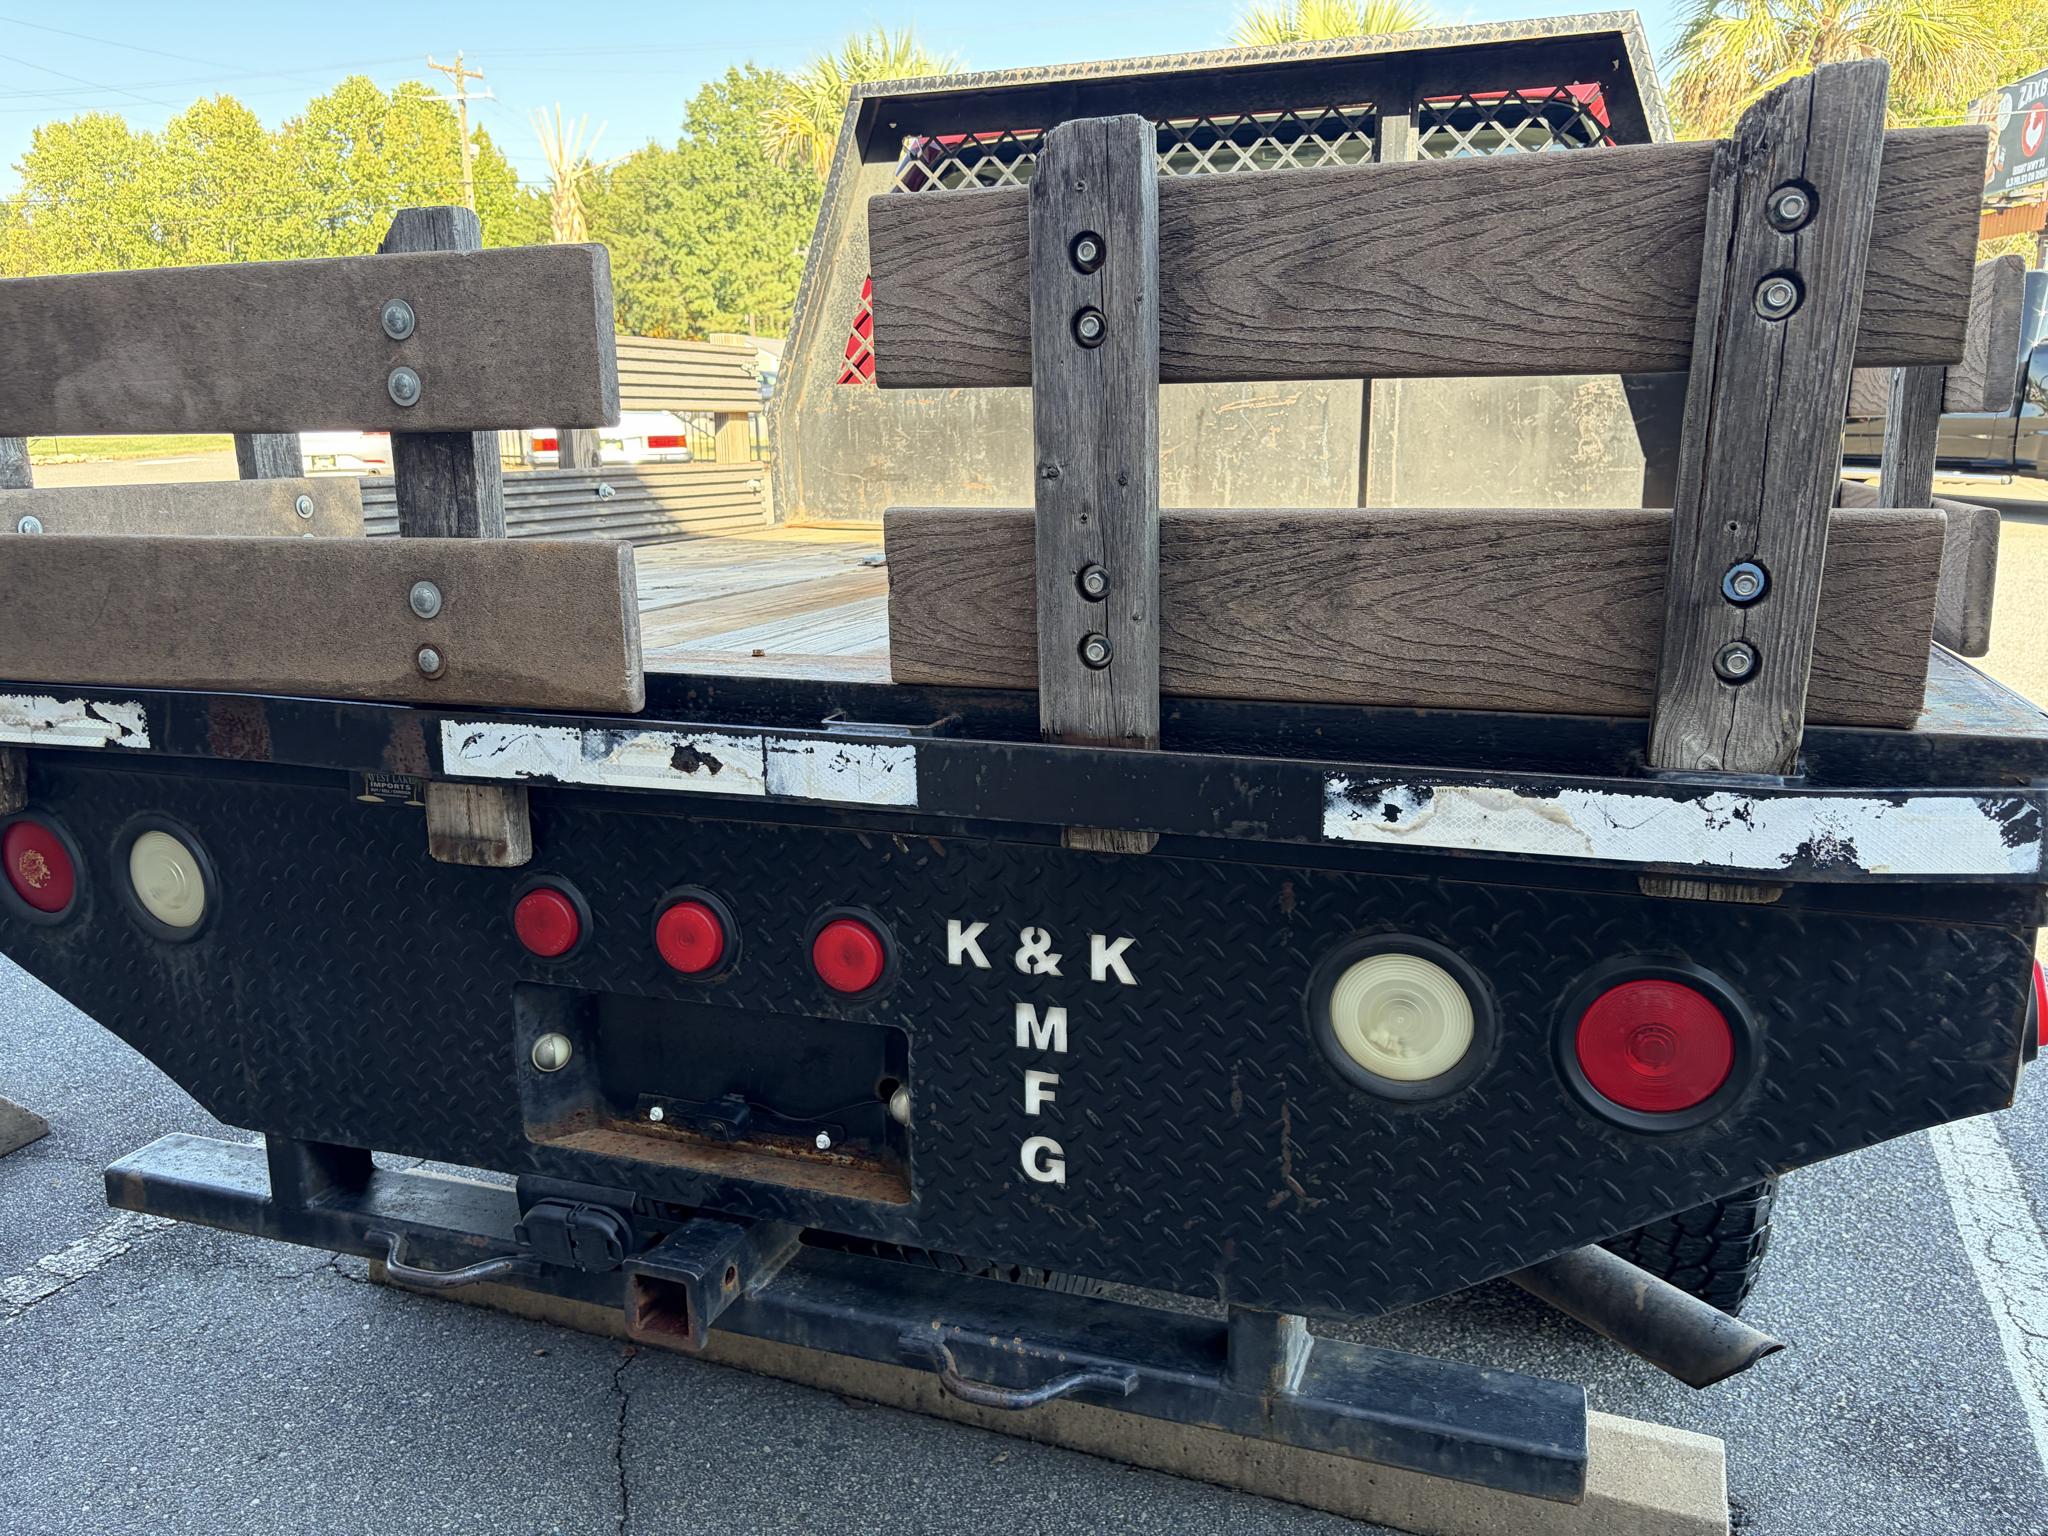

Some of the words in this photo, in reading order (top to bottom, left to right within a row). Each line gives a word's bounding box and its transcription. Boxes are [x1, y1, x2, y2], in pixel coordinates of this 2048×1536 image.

[368, 773, 389, 783] WEST
[370, 781, 412, 791] IMPORTS
[947, 919, 992, 969] K
[1015, 926, 1064, 977] &
[1091, 934, 1138, 986] K
